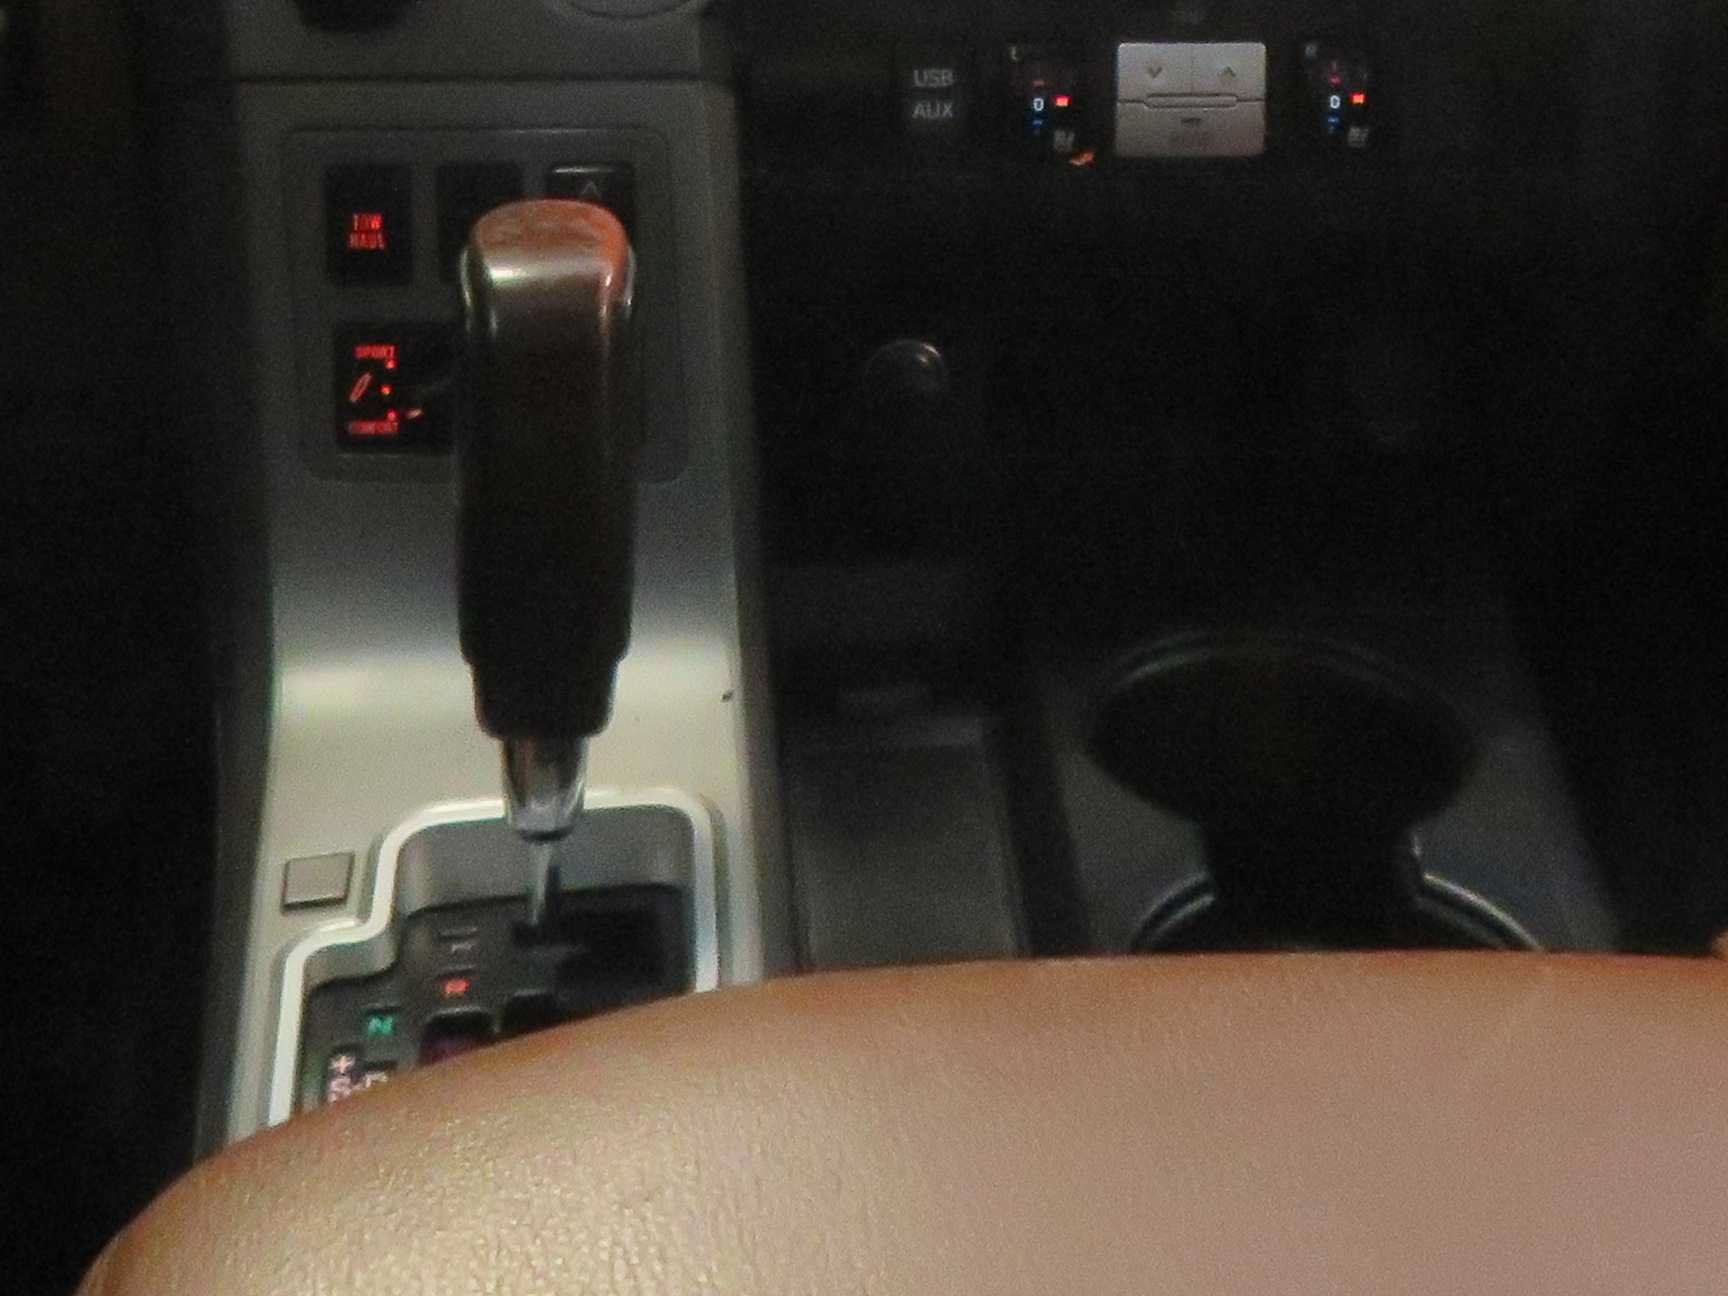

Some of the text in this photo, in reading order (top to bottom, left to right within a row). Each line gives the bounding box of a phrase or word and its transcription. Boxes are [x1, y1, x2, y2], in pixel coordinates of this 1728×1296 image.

[912, 68, 955, 88] USB
[912, 101, 954, 120] AUX
[352, 213, 383, 231] TOW
